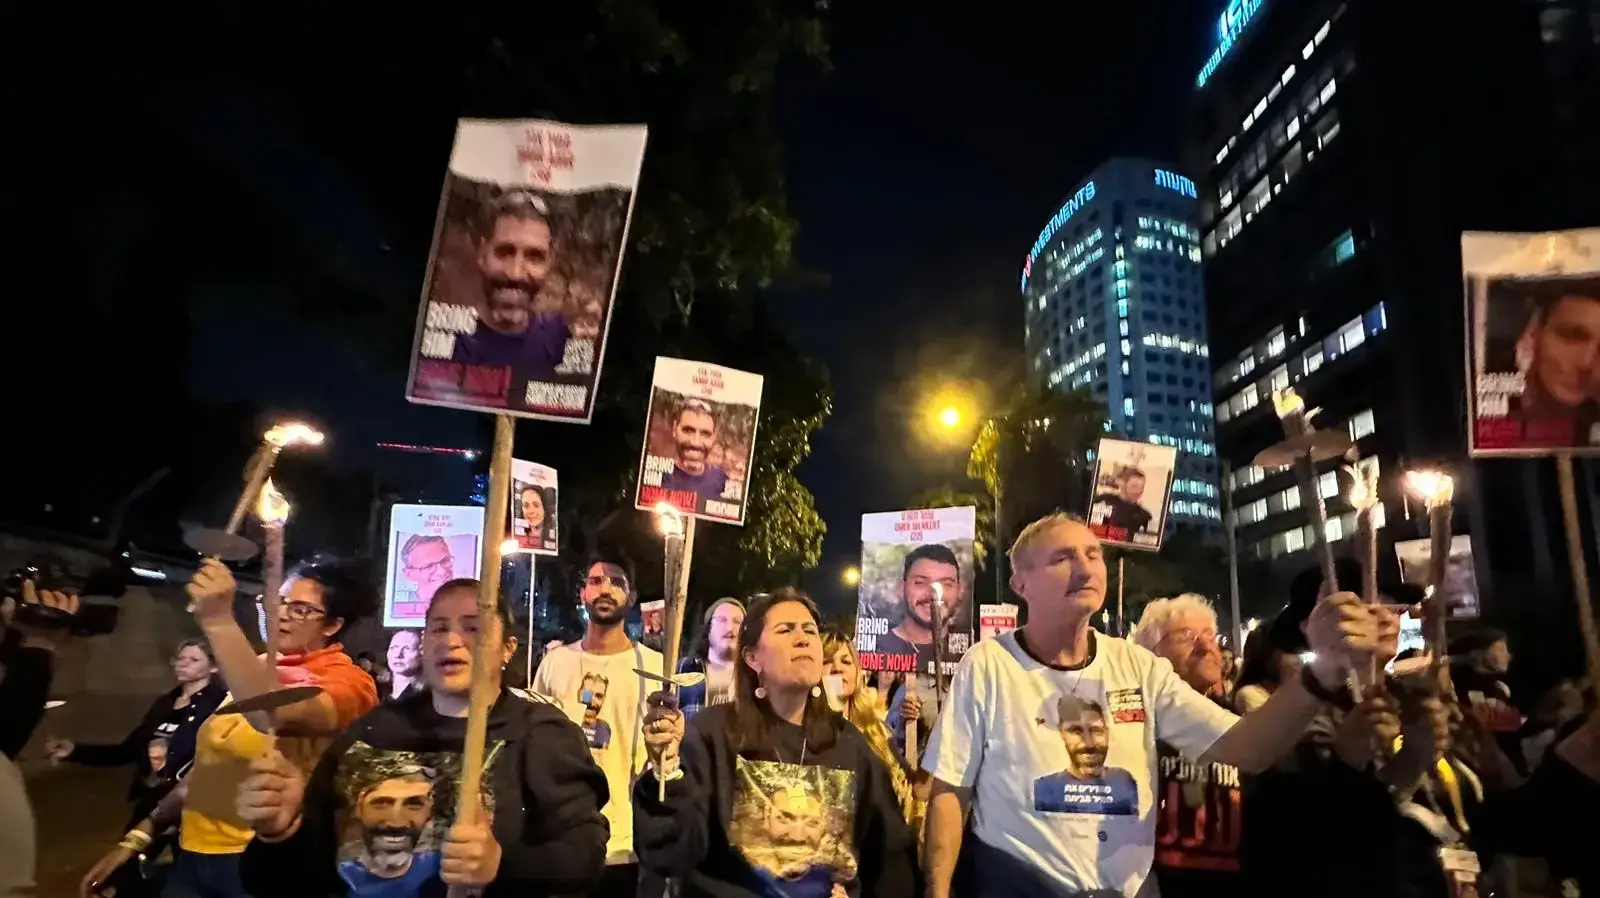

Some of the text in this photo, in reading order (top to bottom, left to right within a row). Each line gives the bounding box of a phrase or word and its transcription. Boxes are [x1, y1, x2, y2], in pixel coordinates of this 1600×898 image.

[1030, 180, 1096, 264] INVESTMENTS
[645, 455, 675, 474] BRING
[858, 617, 889, 635] BRING
[857, 634, 877, 652] HIM
[886, 652, 917, 672] NOW!
